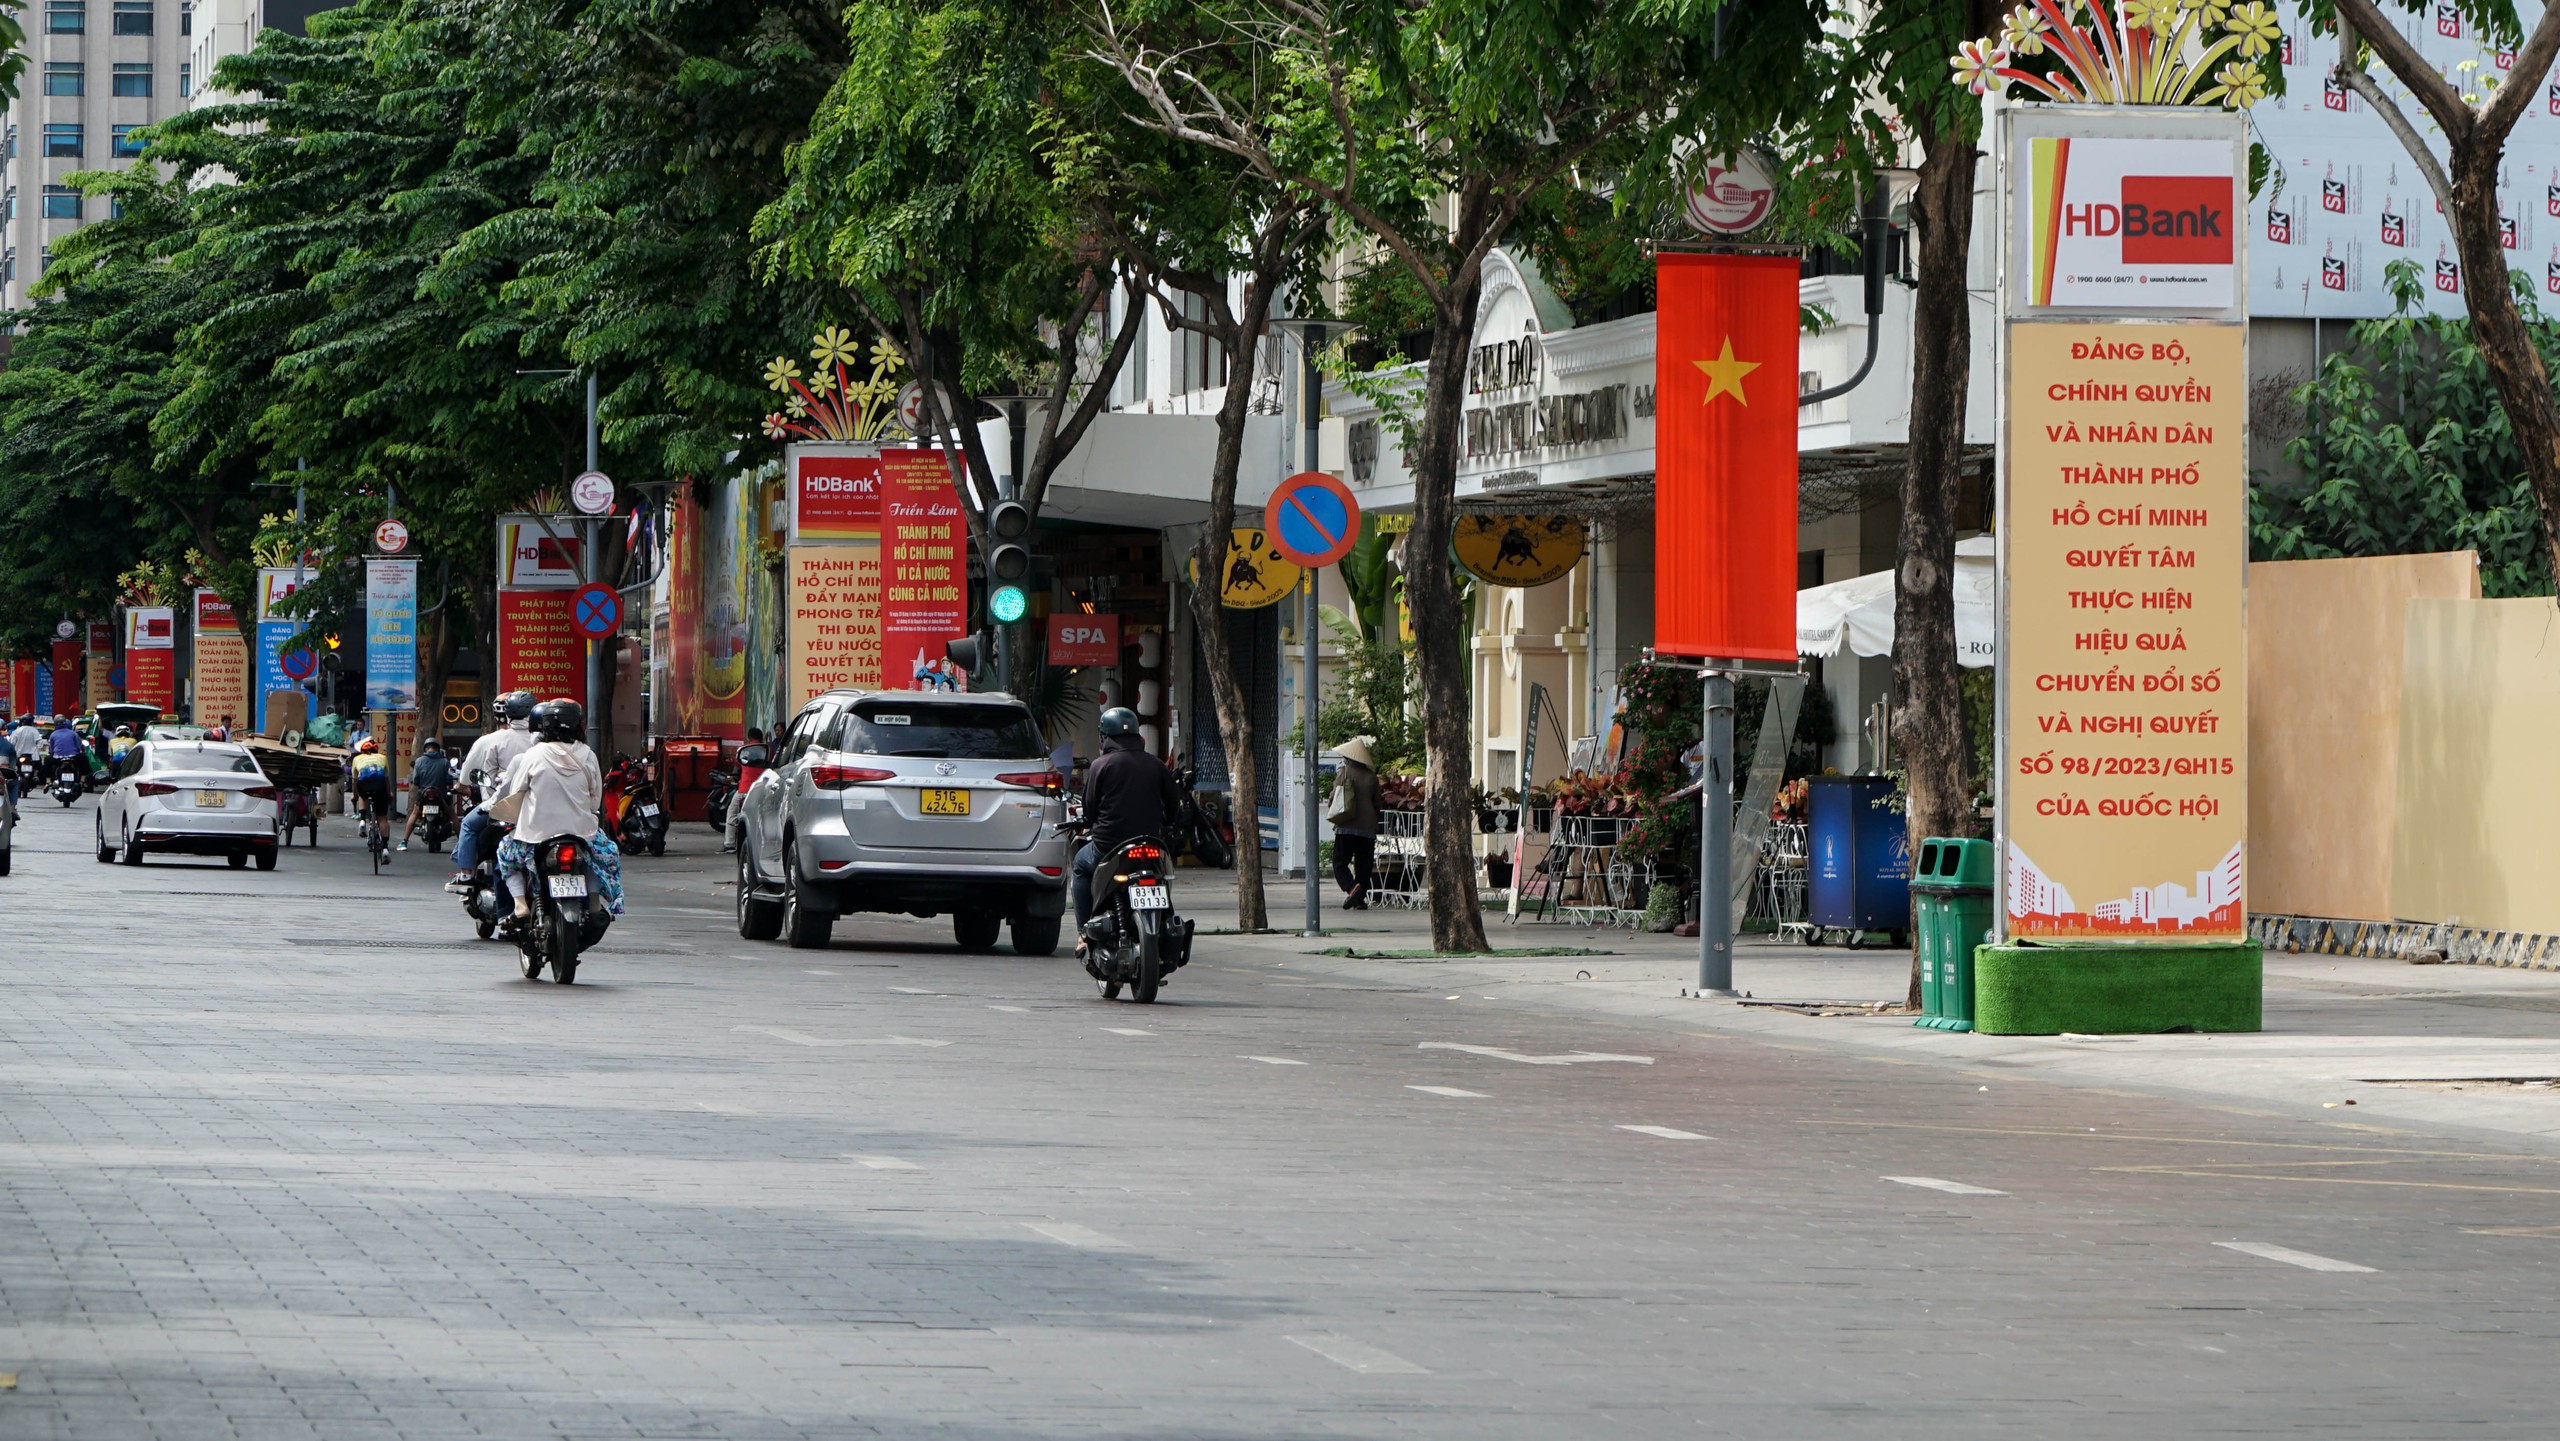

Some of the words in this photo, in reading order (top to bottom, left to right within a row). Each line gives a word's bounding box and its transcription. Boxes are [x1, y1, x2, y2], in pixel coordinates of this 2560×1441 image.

[2441, 5, 2455, 35] SK
[2325, 181, 2341, 210] SK
[2066, 203, 2222, 237] HDBank
[2270, 212, 2287, 240] SK
[2384, 213, 2400, 243] SK
[2077, 275, 2093, 283] 1900
[2095, 275, 2112, 283] 6060
[2325, 258, 2341, 288] SK
[2439, 260, 2454, 290] SK
[2071, 337, 2144, 361] ĐẢNG
[2152, 339, 2190, 366] BỘ,
[2048, 379, 2127, 402] CHÍNH
[2136, 377, 2211, 403] QUYỀN
[2046, 421, 2080, 443] VÀ
[2089, 421, 2158, 444] NHÂN
[2166, 422, 2213, 444] DÂN
[2061, 462, 2143, 485] THÀNH
[2152, 461, 2199, 485] PHỐ
[807, 477, 873, 492] HDBank
[889, 503, 924, 516] Triển
[2053, 500, 2089, 526] HỒ
[2098, 504, 2142, 526] CHÍ
[2149, 509, 2207, 527] MINH
[897, 522, 929, 539] THÀNH
[931, 521, 951, 540] PHỐ
[894, 543, 907, 560] HỒ
[910, 546, 925, 560] CHÍ
[928, 546, 954, 560] MINH
[2066, 543, 2141, 568] QUYẾT
[2148, 546, 2195, 568] TÂM
[803, 558, 854, 571] THÀNH
[859, 560, 881, 571] PH
[897, 564, 906, 580] VÌ
[909, 563, 921, 581] CẢ
[925, 565, 951, 581] NƯỚC
[797, 571, 820, 587] HỒ
[825, 573, 853, 587] CHÍ
[806, 587, 837, 603] ĐẨY
[842, 593, 881, 606] MẠN
[889, 585, 915, 601] CÙNG
[917, 584, 930, 601] CẢ
[933, 585, 959, 601] NƯỚC
[2069, 589, 2133, 613] THỰC
[2142, 587, 2192, 614] HIỆN
[520, 599, 544, 608] PHÁT
[507, 610, 542, 620] TRUYỀN
[545, 611, 570, 620] THỐN
[797, 608, 853, 619] PHONG
[857, 606, 881, 619] TRÀ
[515, 624, 547, 632] THÀNH
[550, 623, 570, 632] PHỐ
[818, 625, 840, 635] THI
[846, 625, 876, 635] ĐUA
[1061, 627, 1106, 644] SPA
[512, 635, 526, 645] HỒ
[529, 636, 546, 645] CHÍ
[806, 638, 834, 651] YÊU
[838, 638, 881, 651] NƯỚC
[2076, 629, 2128, 655] HIỆU
[2136, 627, 2186, 651] QUẢ
[519, 648, 547, 657] ĐOÀN
[806, 652, 853, 667] QUYẾT
[517, 673, 544, 682] SÁNG
[808, 671, 848, 687] THỰC
[2036, 665, 2135, 692] CHUYỂN
[2143, 666, 2184, 692] ĐỔI
[2191, 668, 2221, 692] SỐ
[2038, 711, 2072, 733] VÀ
[2081, 716, 2142, 738] NGHỊ
[2150, 709, 2219, 734] QUYẾT
[2020, 750, 2054, 775] SỐ
[2061, 758, 2234, 776] 98/2023/QH15
[935, 791, 956, 801] 51G
[926, 802, 965, 813] 424.76
[2037, 793, 2090, 816] CỦA
[2098, 792, 2172, 817] QUỐC
[2180, 794, 2219, 820] HỘI
[555, 877, 579, 886] 92-E1
[553, 887, 585, 896] 592.74
[1135, 887, 1161, 897] 83-V1
[1133, 897, 1167, 907] 091.33
